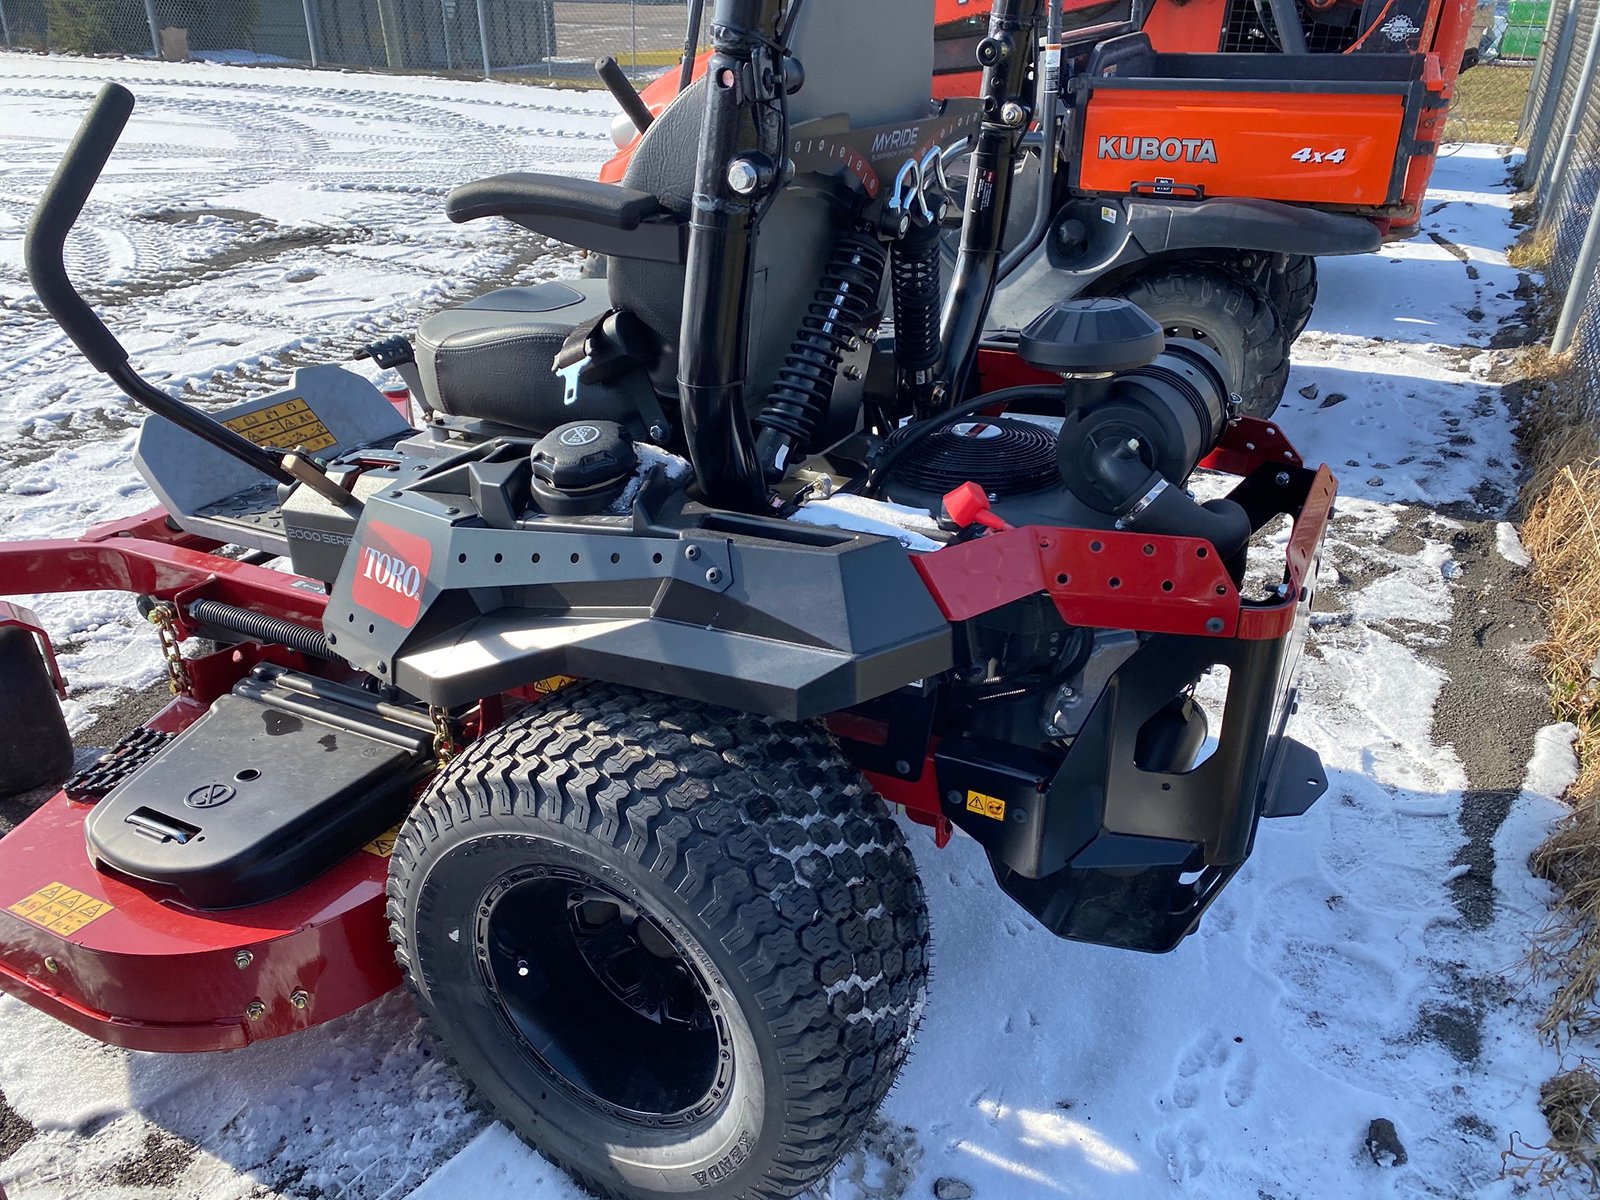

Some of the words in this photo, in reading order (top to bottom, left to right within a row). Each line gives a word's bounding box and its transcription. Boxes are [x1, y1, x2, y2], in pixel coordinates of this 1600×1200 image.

[1097, 136, 1218, 163] KUBOTA
[1291, 147, 1347, 164] 4x4
[288, 528, 321, 541] 2000
[363, 546, 421, 598] TORO
[691, 1130, 757, 1189] KENDA
